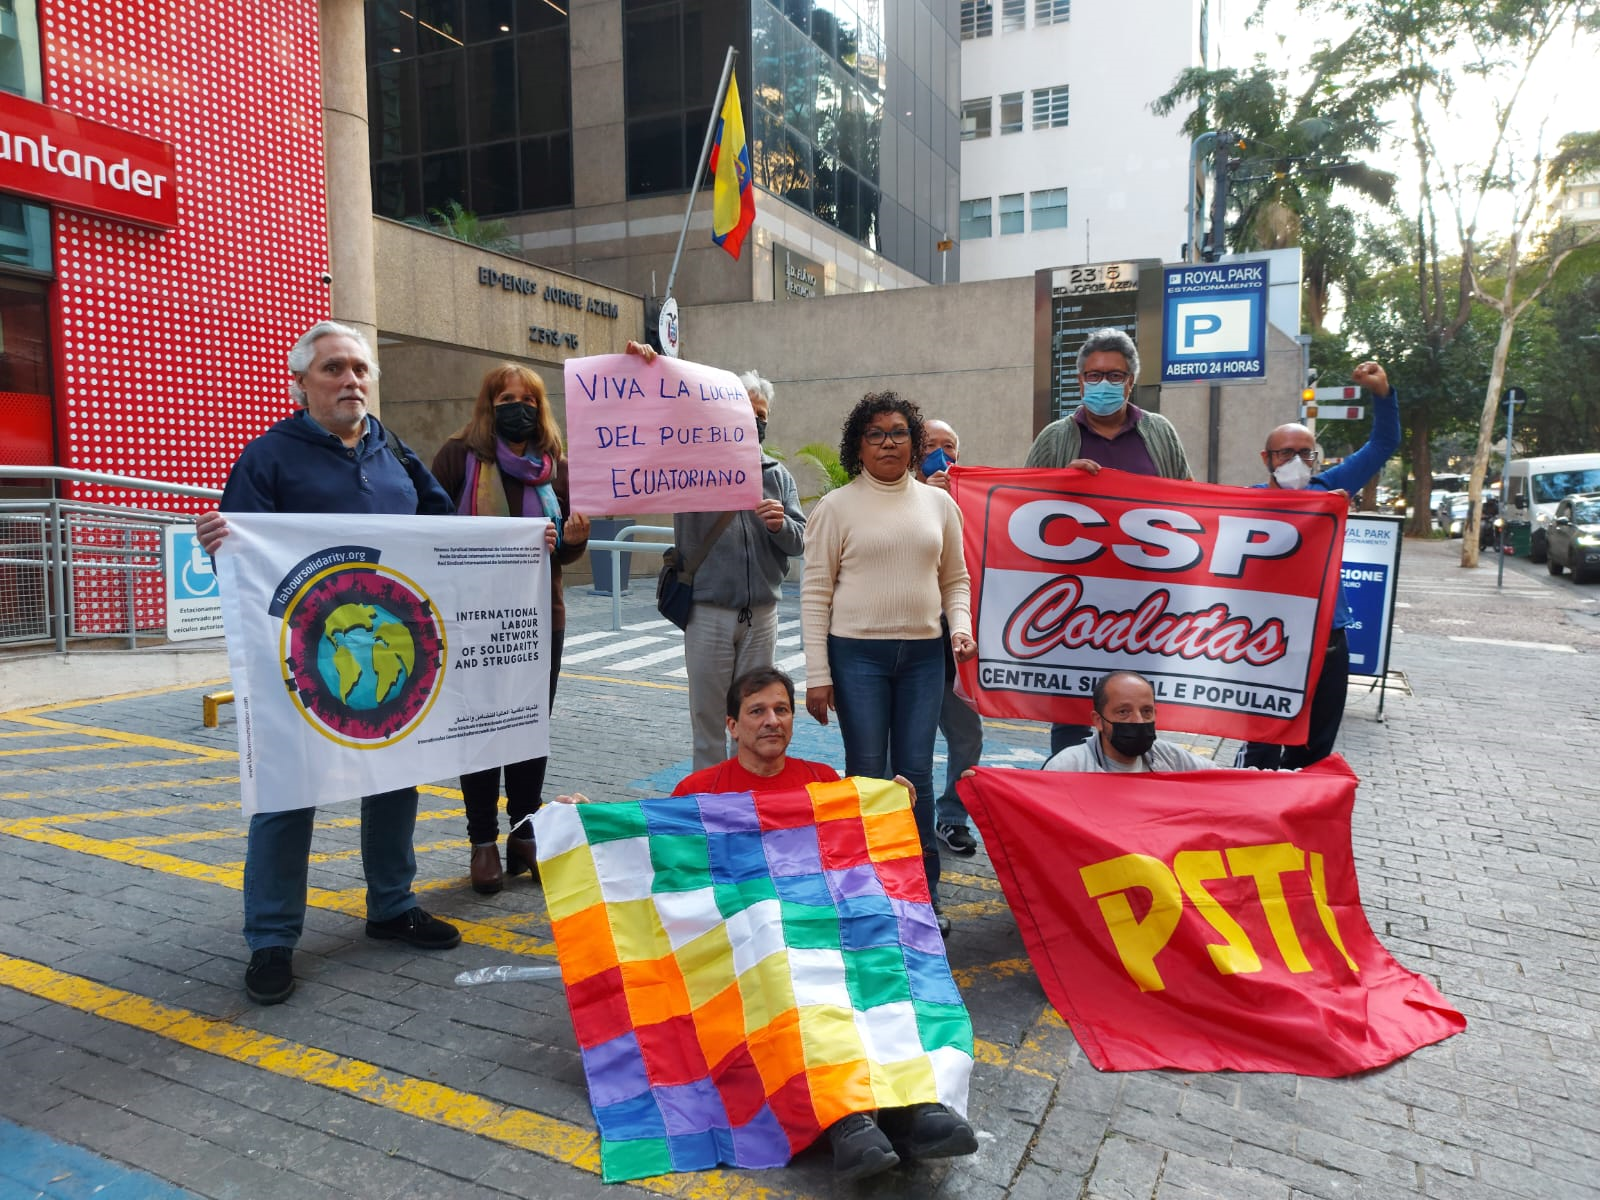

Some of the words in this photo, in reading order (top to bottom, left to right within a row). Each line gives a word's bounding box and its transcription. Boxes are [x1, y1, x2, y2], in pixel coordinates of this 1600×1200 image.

[1184, 271, 1226, 285] ROYAL
[1228, 267, 1262, 282] PARK
[1069, 282, 1106, 294] JORGE
[1167, 281, 1263, 294] ESTACIONAMENTO
[586, 297, 619, 320] AZEM
[1184, 314, 1222, 348] P
[1166, 363, 1208, 376] ABERTO
[1209, 362, 1221, 374] 24
[1223, 360, 1260, 373] HORAS
[576, 374, 645, 401] VIVA
[660, 378, 690, 399] LA
[699, 383, 745, 401] LUCHA
[595, 425, 646, 449] DEL
[659, 426, 745, 446] PUEBLO
[611, 468, 746, 499] ECUATORIANO
[1007, 500, 1303, 578] CSP
[1364, 529, 1391, 539] PARK
[277, 551, 366, 604] laboursolidarity.org
[456, 608, 538, 622] INTERNATIONAL
[501, 618, 538, 630] LABOUR
[1002, 574, 1289, 666] Conlutas
[490, 629, 538, 642] NETWORK
[462, 647, 475, 656] OF
[480, 640, 538, 655] SOLIDARITY
[455, 659, 478, 669] AND
[482, 652, 539, 667] STRUGGLES
[982, 668, 1071, 691] CENTRAL
[1174, 683, 1187, 698] E
[1192, 685, 1292, 713] POPULAR
